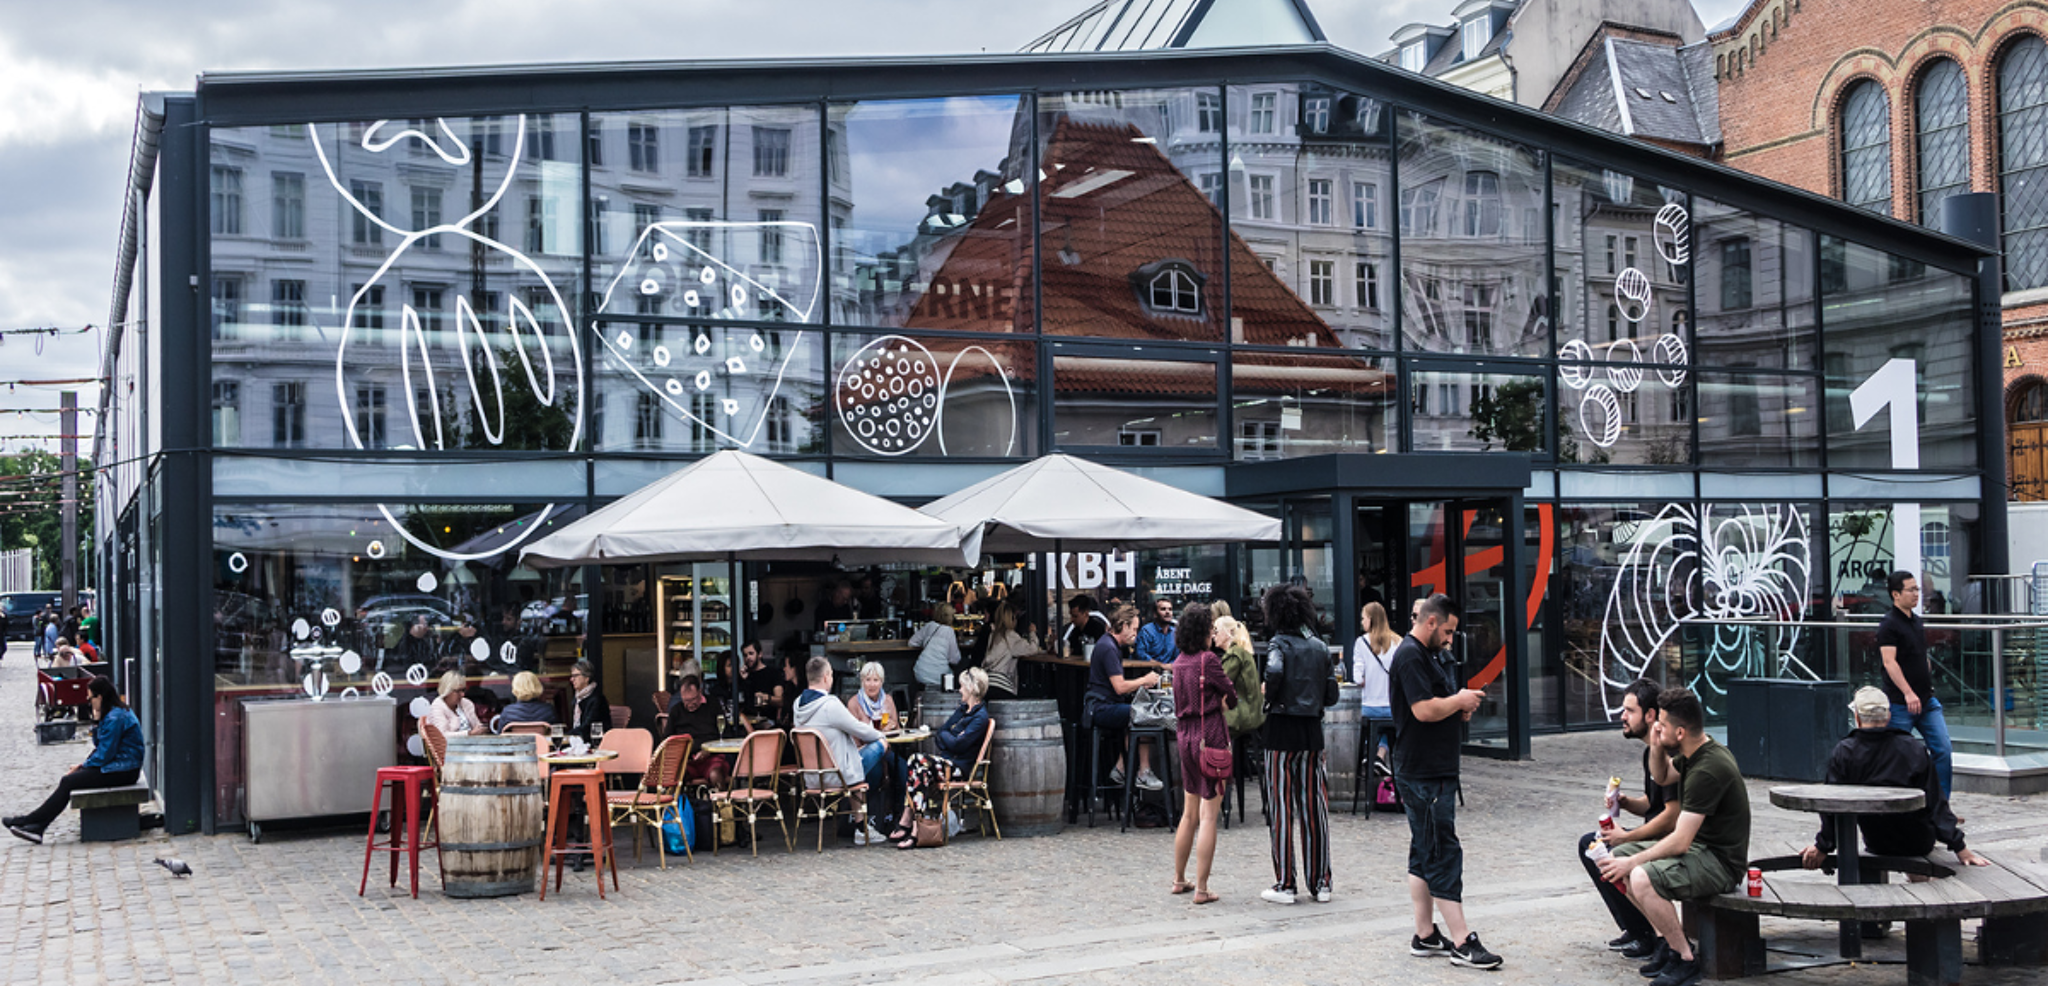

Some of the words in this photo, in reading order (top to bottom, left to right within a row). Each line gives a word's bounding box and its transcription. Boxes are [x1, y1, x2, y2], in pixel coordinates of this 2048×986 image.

[2004, 345, 2024, 368] A
[1849, 358, 1921, 614] 1
[1046, 549, 1135, 589] KBH
[1155, 566, 1192, 580] ÅBENT
[1155, 583, 1182, 594] ALLE
[1184, 582, 1212, 593] DAGE
